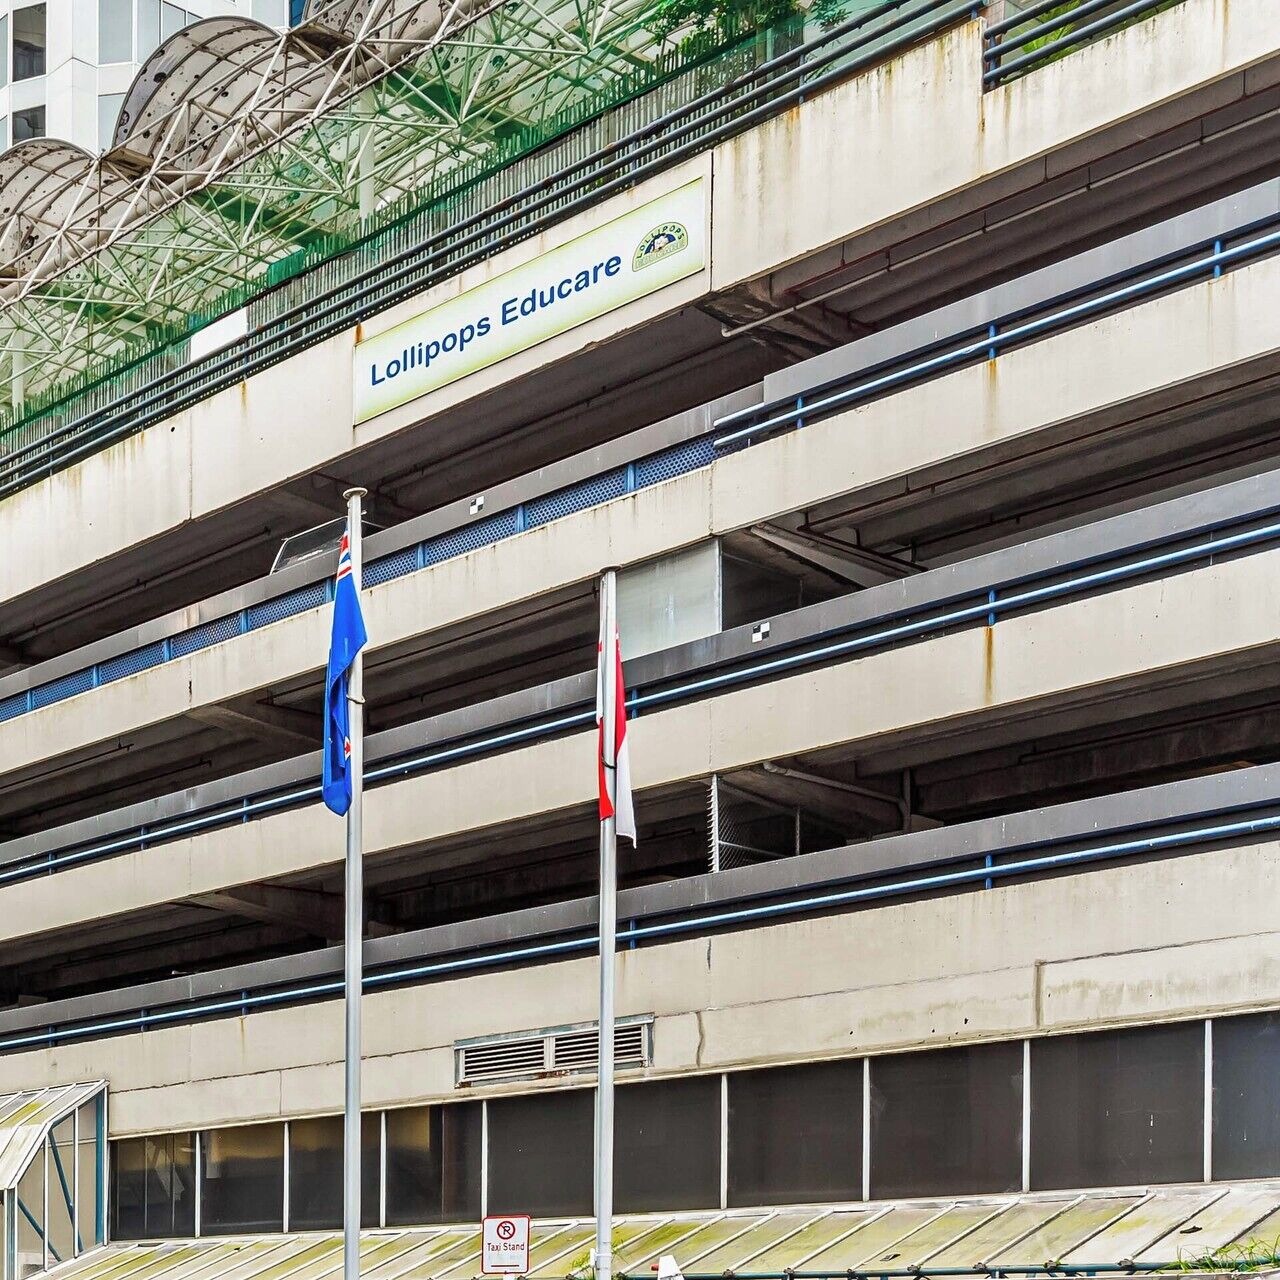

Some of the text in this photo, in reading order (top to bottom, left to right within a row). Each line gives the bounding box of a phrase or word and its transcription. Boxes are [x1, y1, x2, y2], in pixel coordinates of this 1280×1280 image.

[371, 255, 622, 386] Lollipops Educare
[487, 1242, 525, 1252] Taxi Stand
